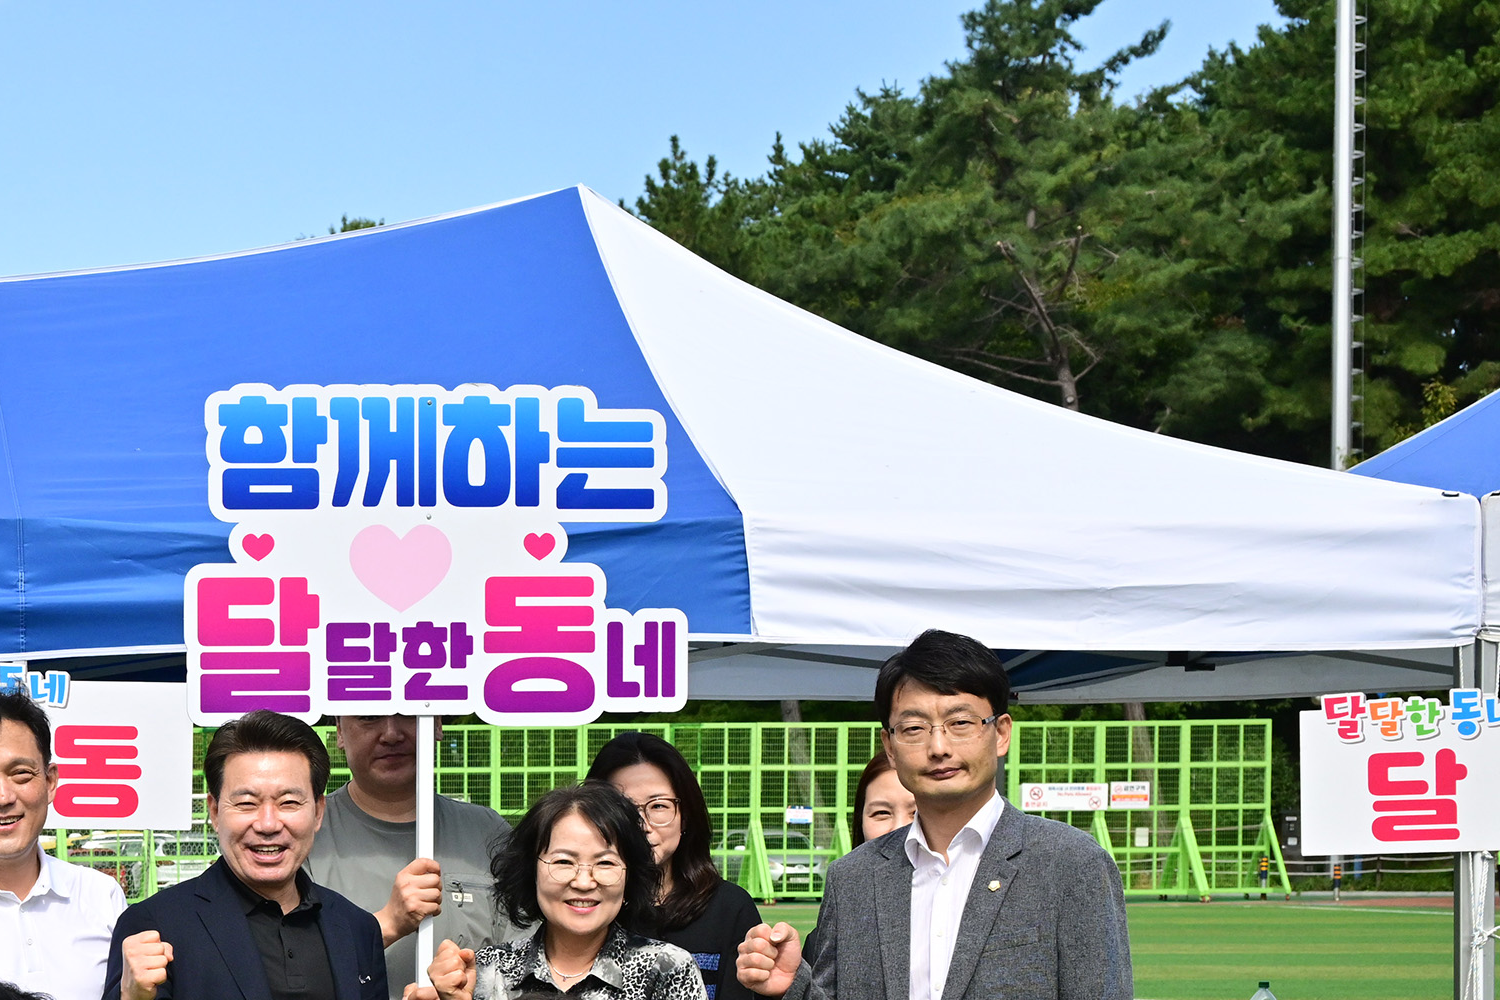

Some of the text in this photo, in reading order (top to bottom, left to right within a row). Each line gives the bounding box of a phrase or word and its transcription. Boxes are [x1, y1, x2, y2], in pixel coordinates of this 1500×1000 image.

[218, 395, 655, 510] 함께하는
[197, 576, 676, 713] 달달한 동네
[1324, 695, 1441, 740] 달달한
[1368, 748, 1468, 842] 달
